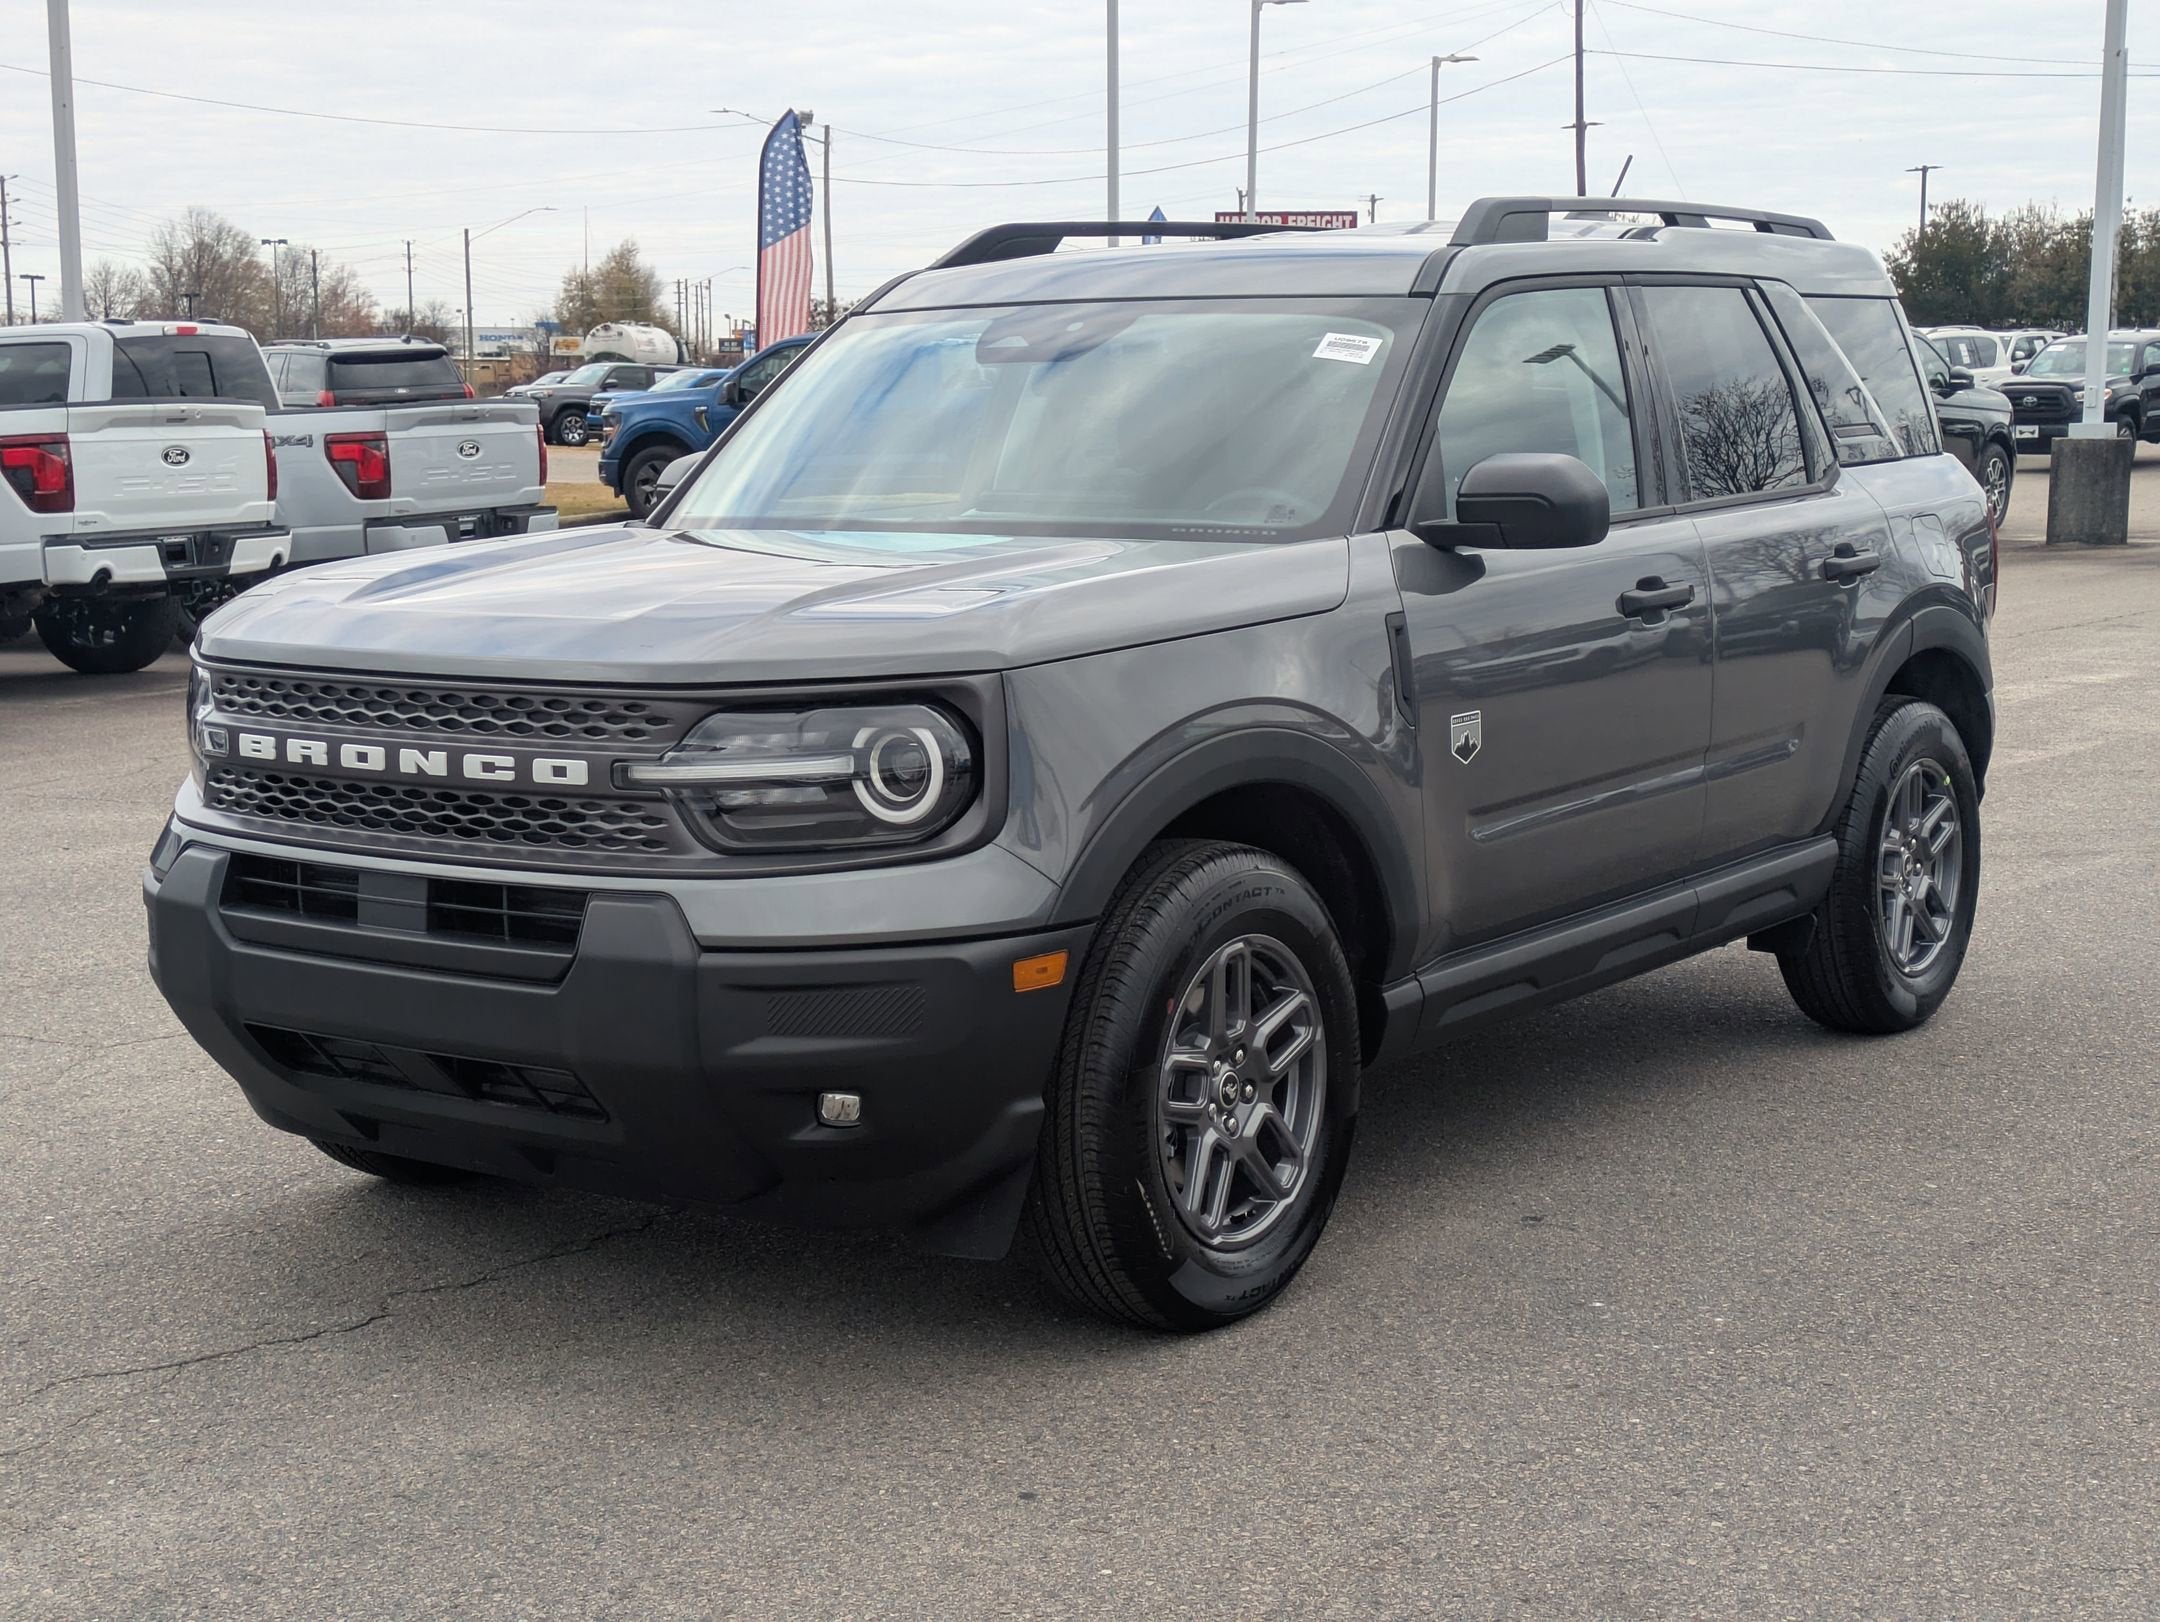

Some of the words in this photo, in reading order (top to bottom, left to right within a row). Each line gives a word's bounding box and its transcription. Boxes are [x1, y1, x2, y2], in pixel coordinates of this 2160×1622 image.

[1287, 215, 1353, 228] FREIGHT
[479, 334, 524, 342] HONDA
[272, 434, 314, 449] X4
[459, 441, 478, 457] Ford
[164, 449, 188, 465] Ford
[238, 732, 590, 786] BRONCO
